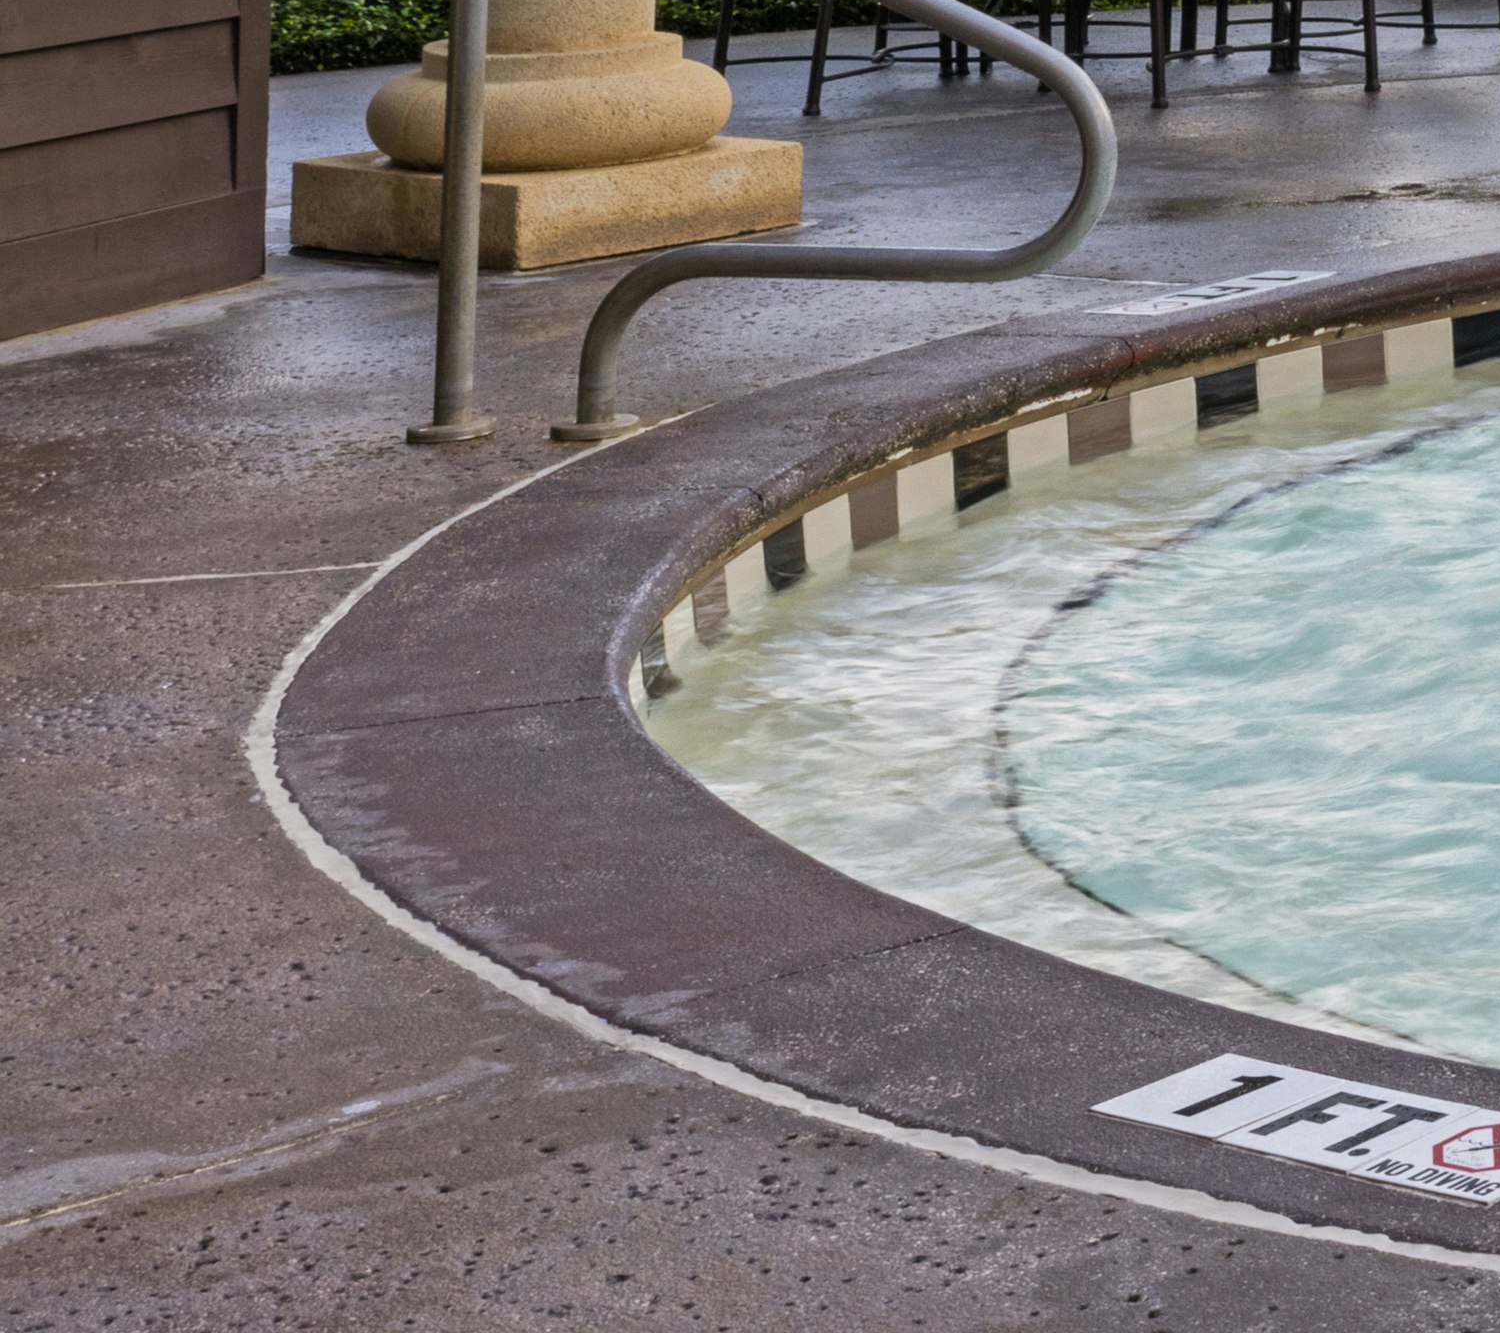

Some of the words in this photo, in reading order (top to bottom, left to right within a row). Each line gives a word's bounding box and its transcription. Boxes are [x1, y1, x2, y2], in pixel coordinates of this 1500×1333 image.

[1172, 1075, 1284, 1117] 1
[1249, 1091, 1450, 1156] FT.
[1366, 1159, 1415, 1177] NO
